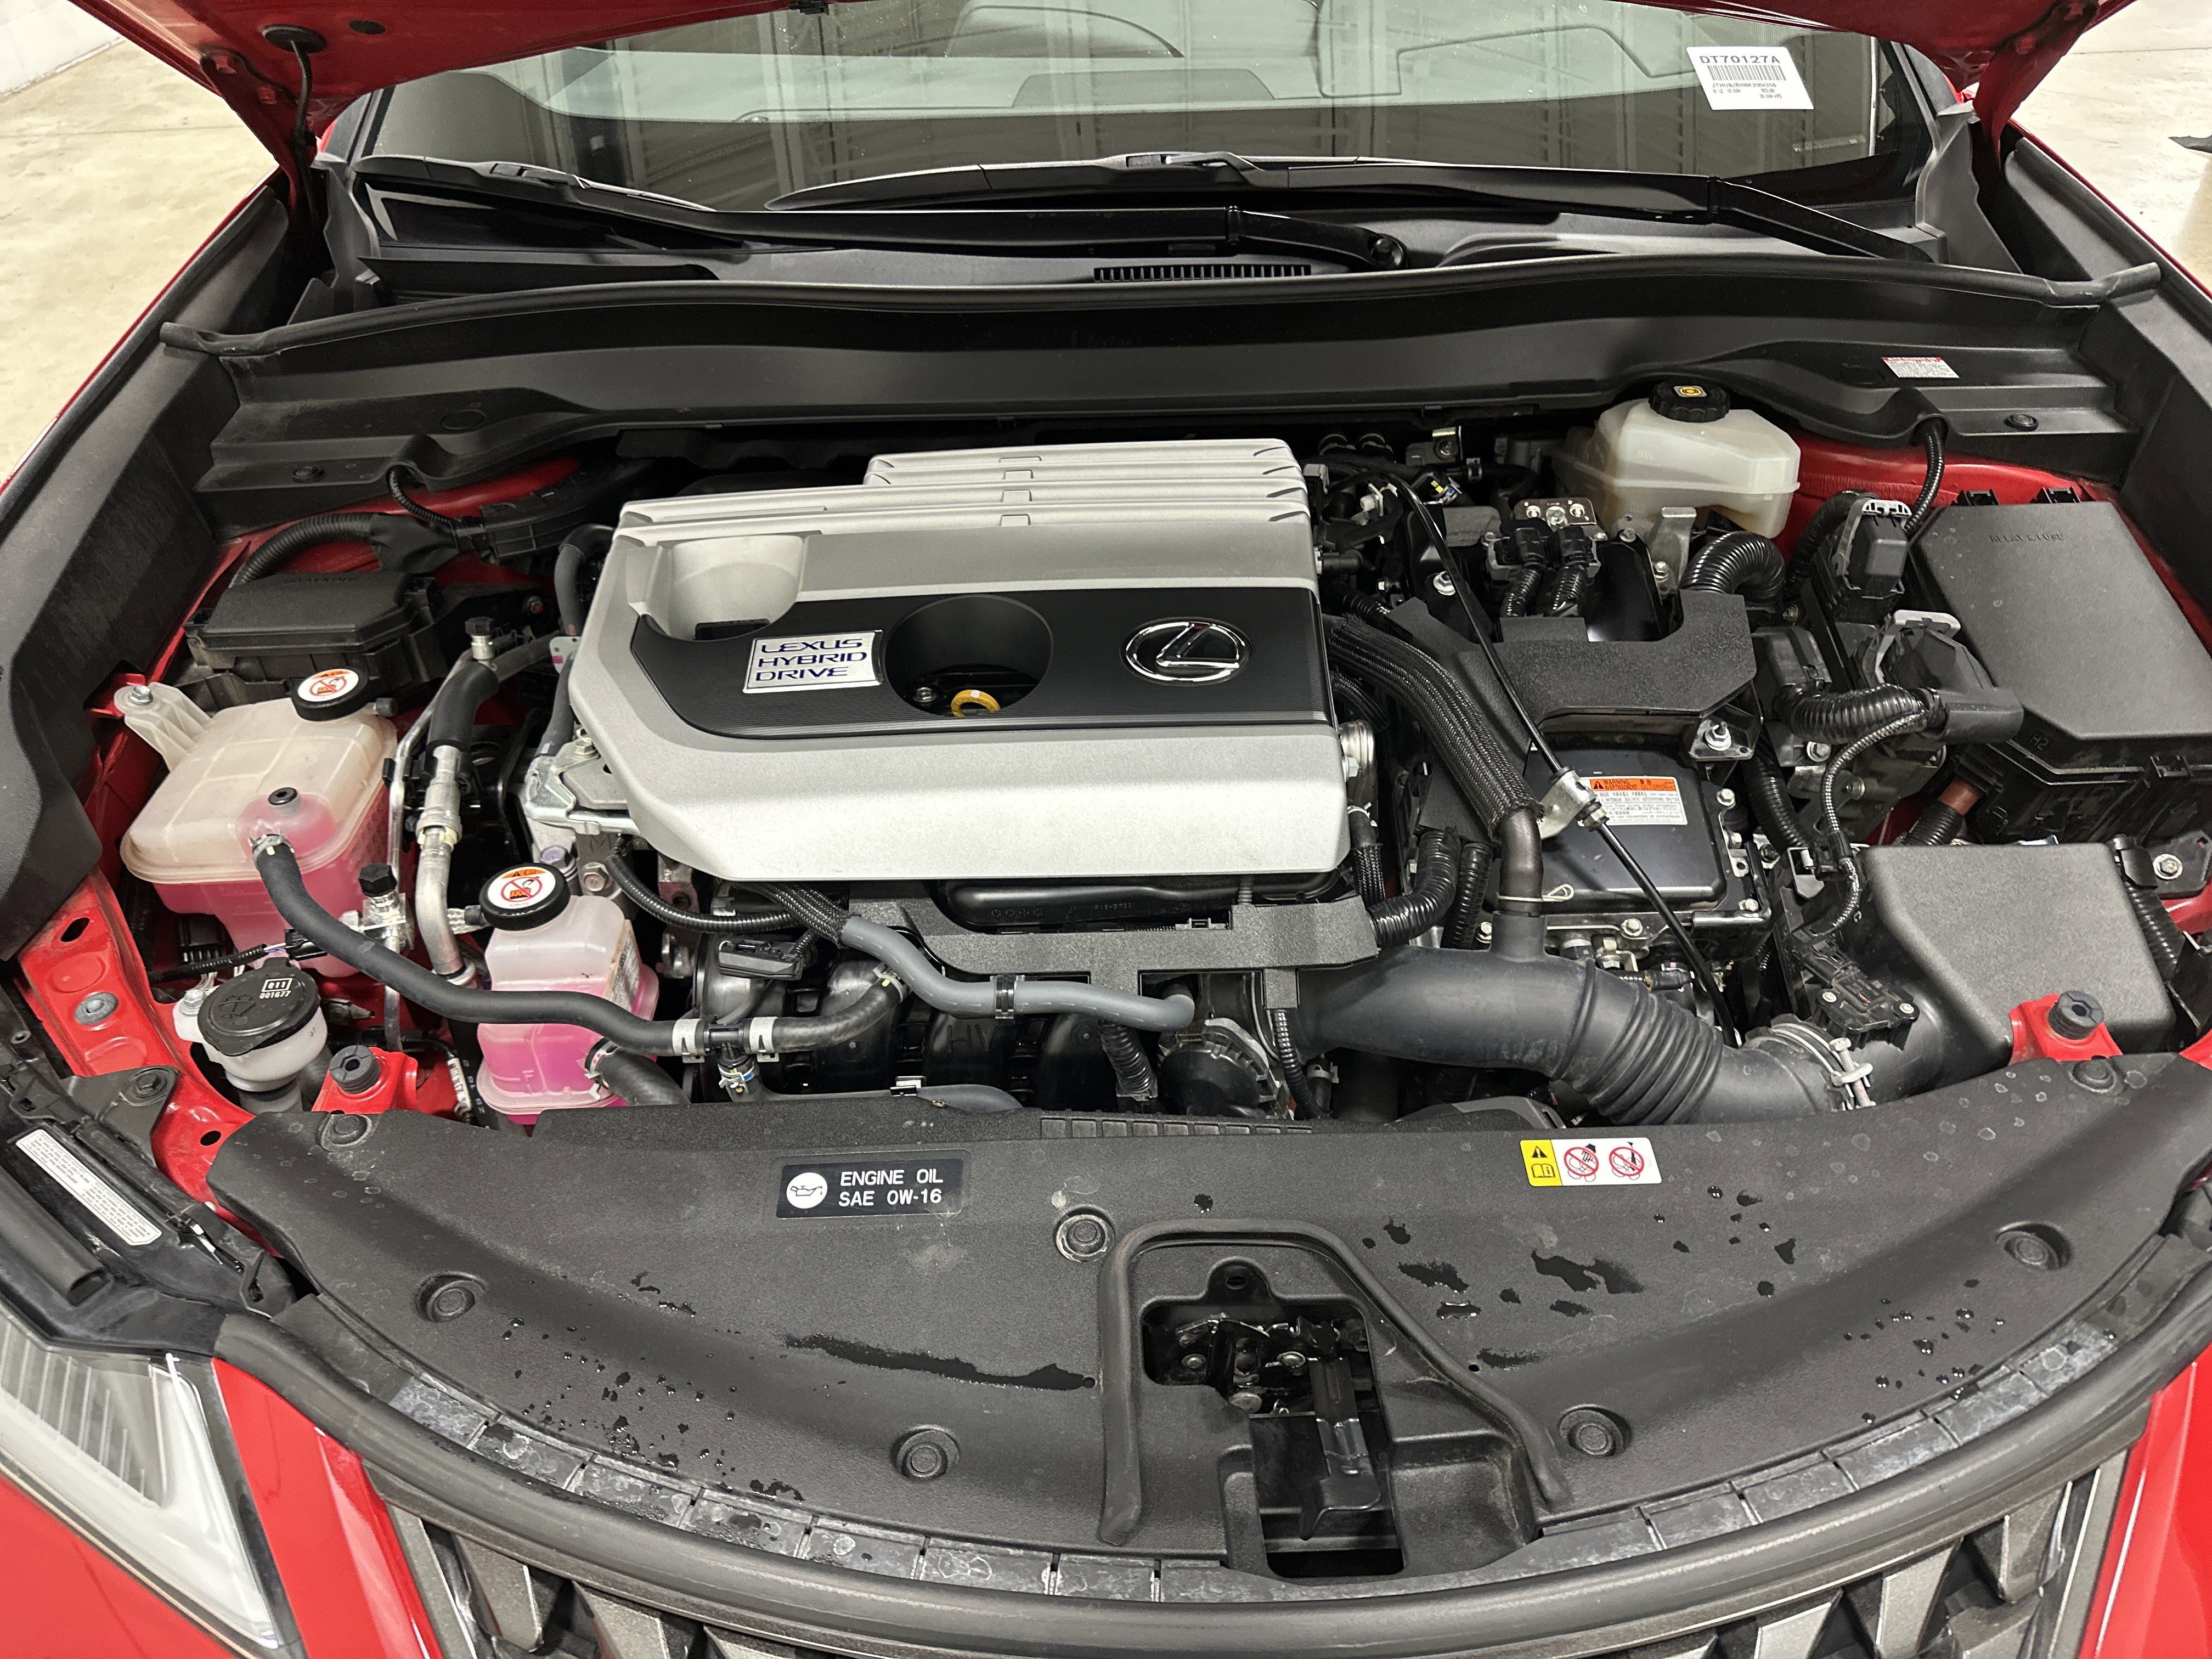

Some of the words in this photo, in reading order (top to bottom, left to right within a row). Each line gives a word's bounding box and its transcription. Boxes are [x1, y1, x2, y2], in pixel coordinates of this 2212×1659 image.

[1699, 55, 1780, 64] DT70127A
[761, 639, 863, 653] LEXUS
[758, 652, 867, 667] HYBRID
[755, 666, 849, 681] DRIVE
[268, 981, 286, 989] e11
[259, 990, 291, 999] 001677
[840, 1169, 905, 1187] ENGINE
[916, 1169, 944, 1183] OIL
[838, 1190, 874, 1207] SAE
[887, 1188, 942, 1205] 0W-16
